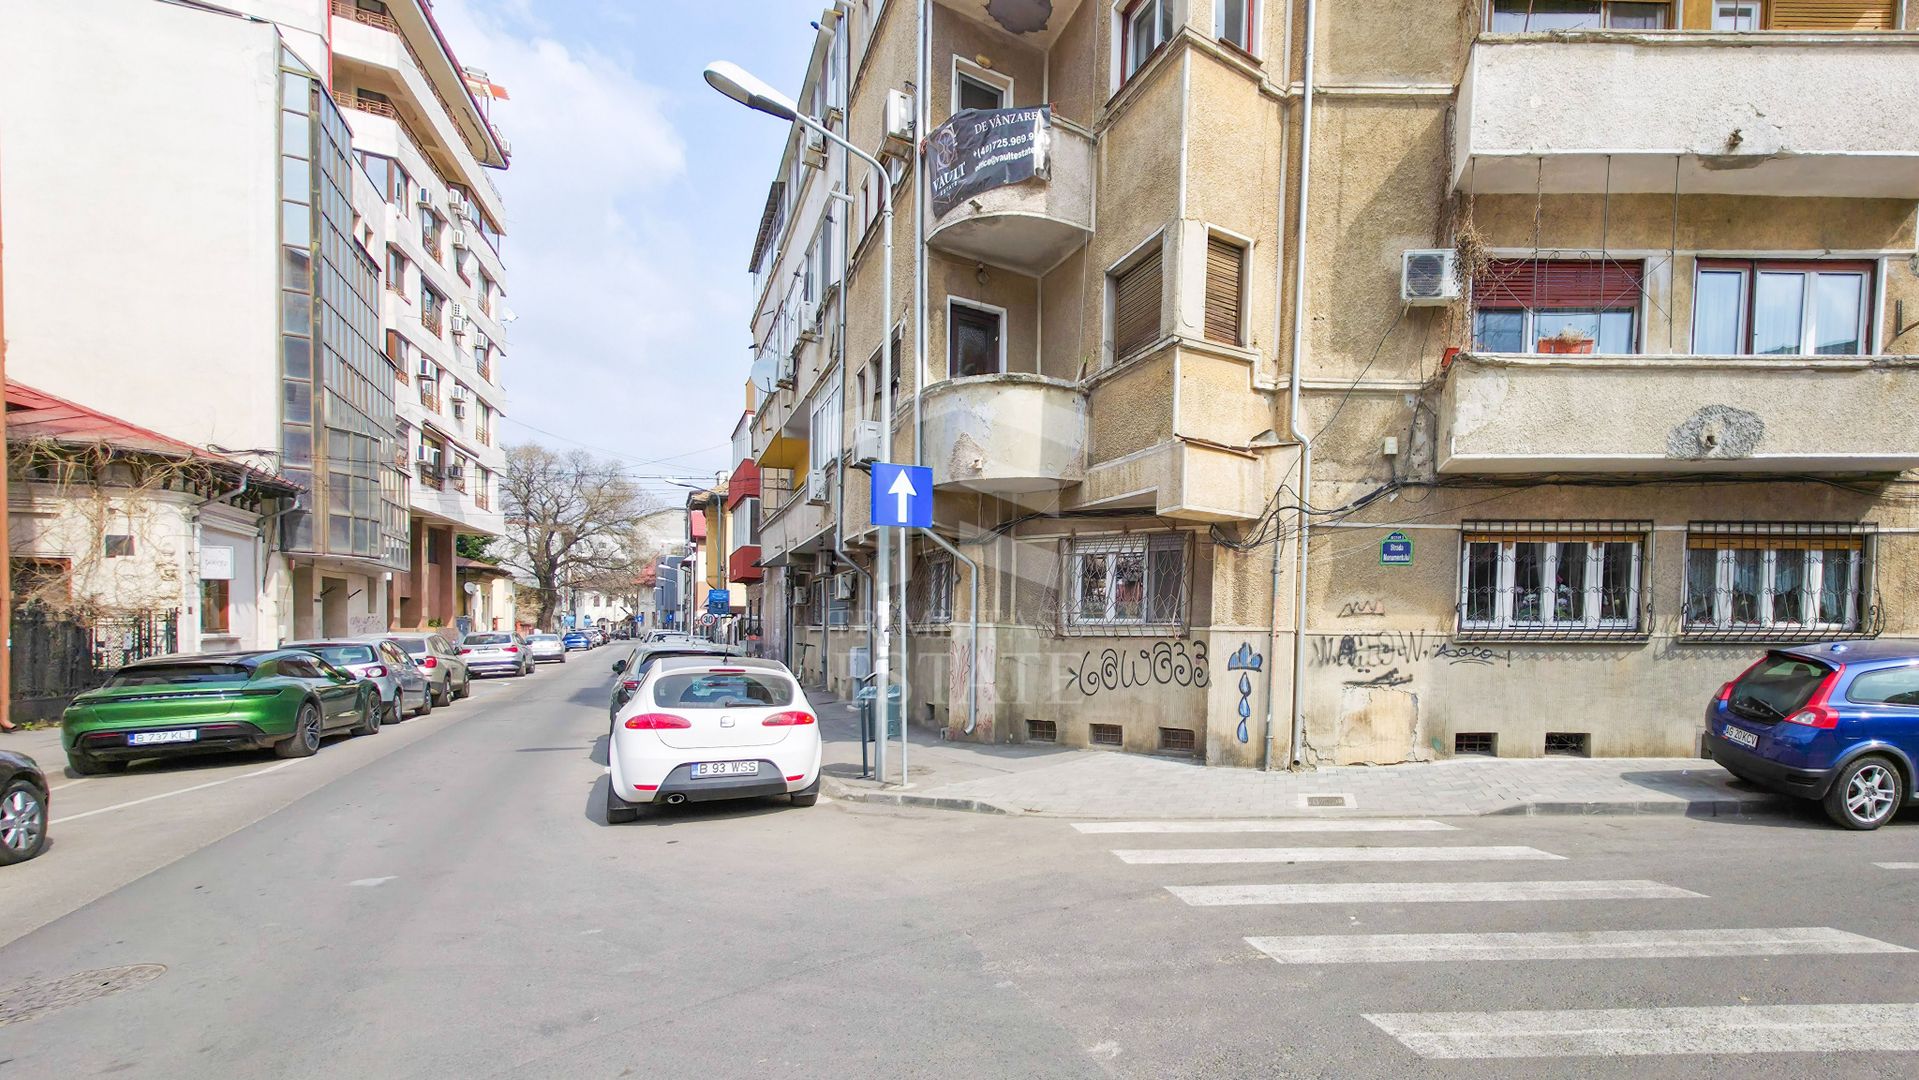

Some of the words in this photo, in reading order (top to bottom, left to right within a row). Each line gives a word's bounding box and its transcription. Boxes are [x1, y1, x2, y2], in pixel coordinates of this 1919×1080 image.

[974, 123, 989, 135] DE
[989, 111, 1039, 129] VÂNZARE
[932, 161, 966, 192] VAULT
[1390, 543, 1404, 551] Strada
[703, 615, 713, 624] 30
[136, 734, 144, 743] B
[149, 732, 169, 742] 737
[699, 763, 708, 774] B
[712, 763, 726, 774] 93
[731, 761, 757, 773] WSS
